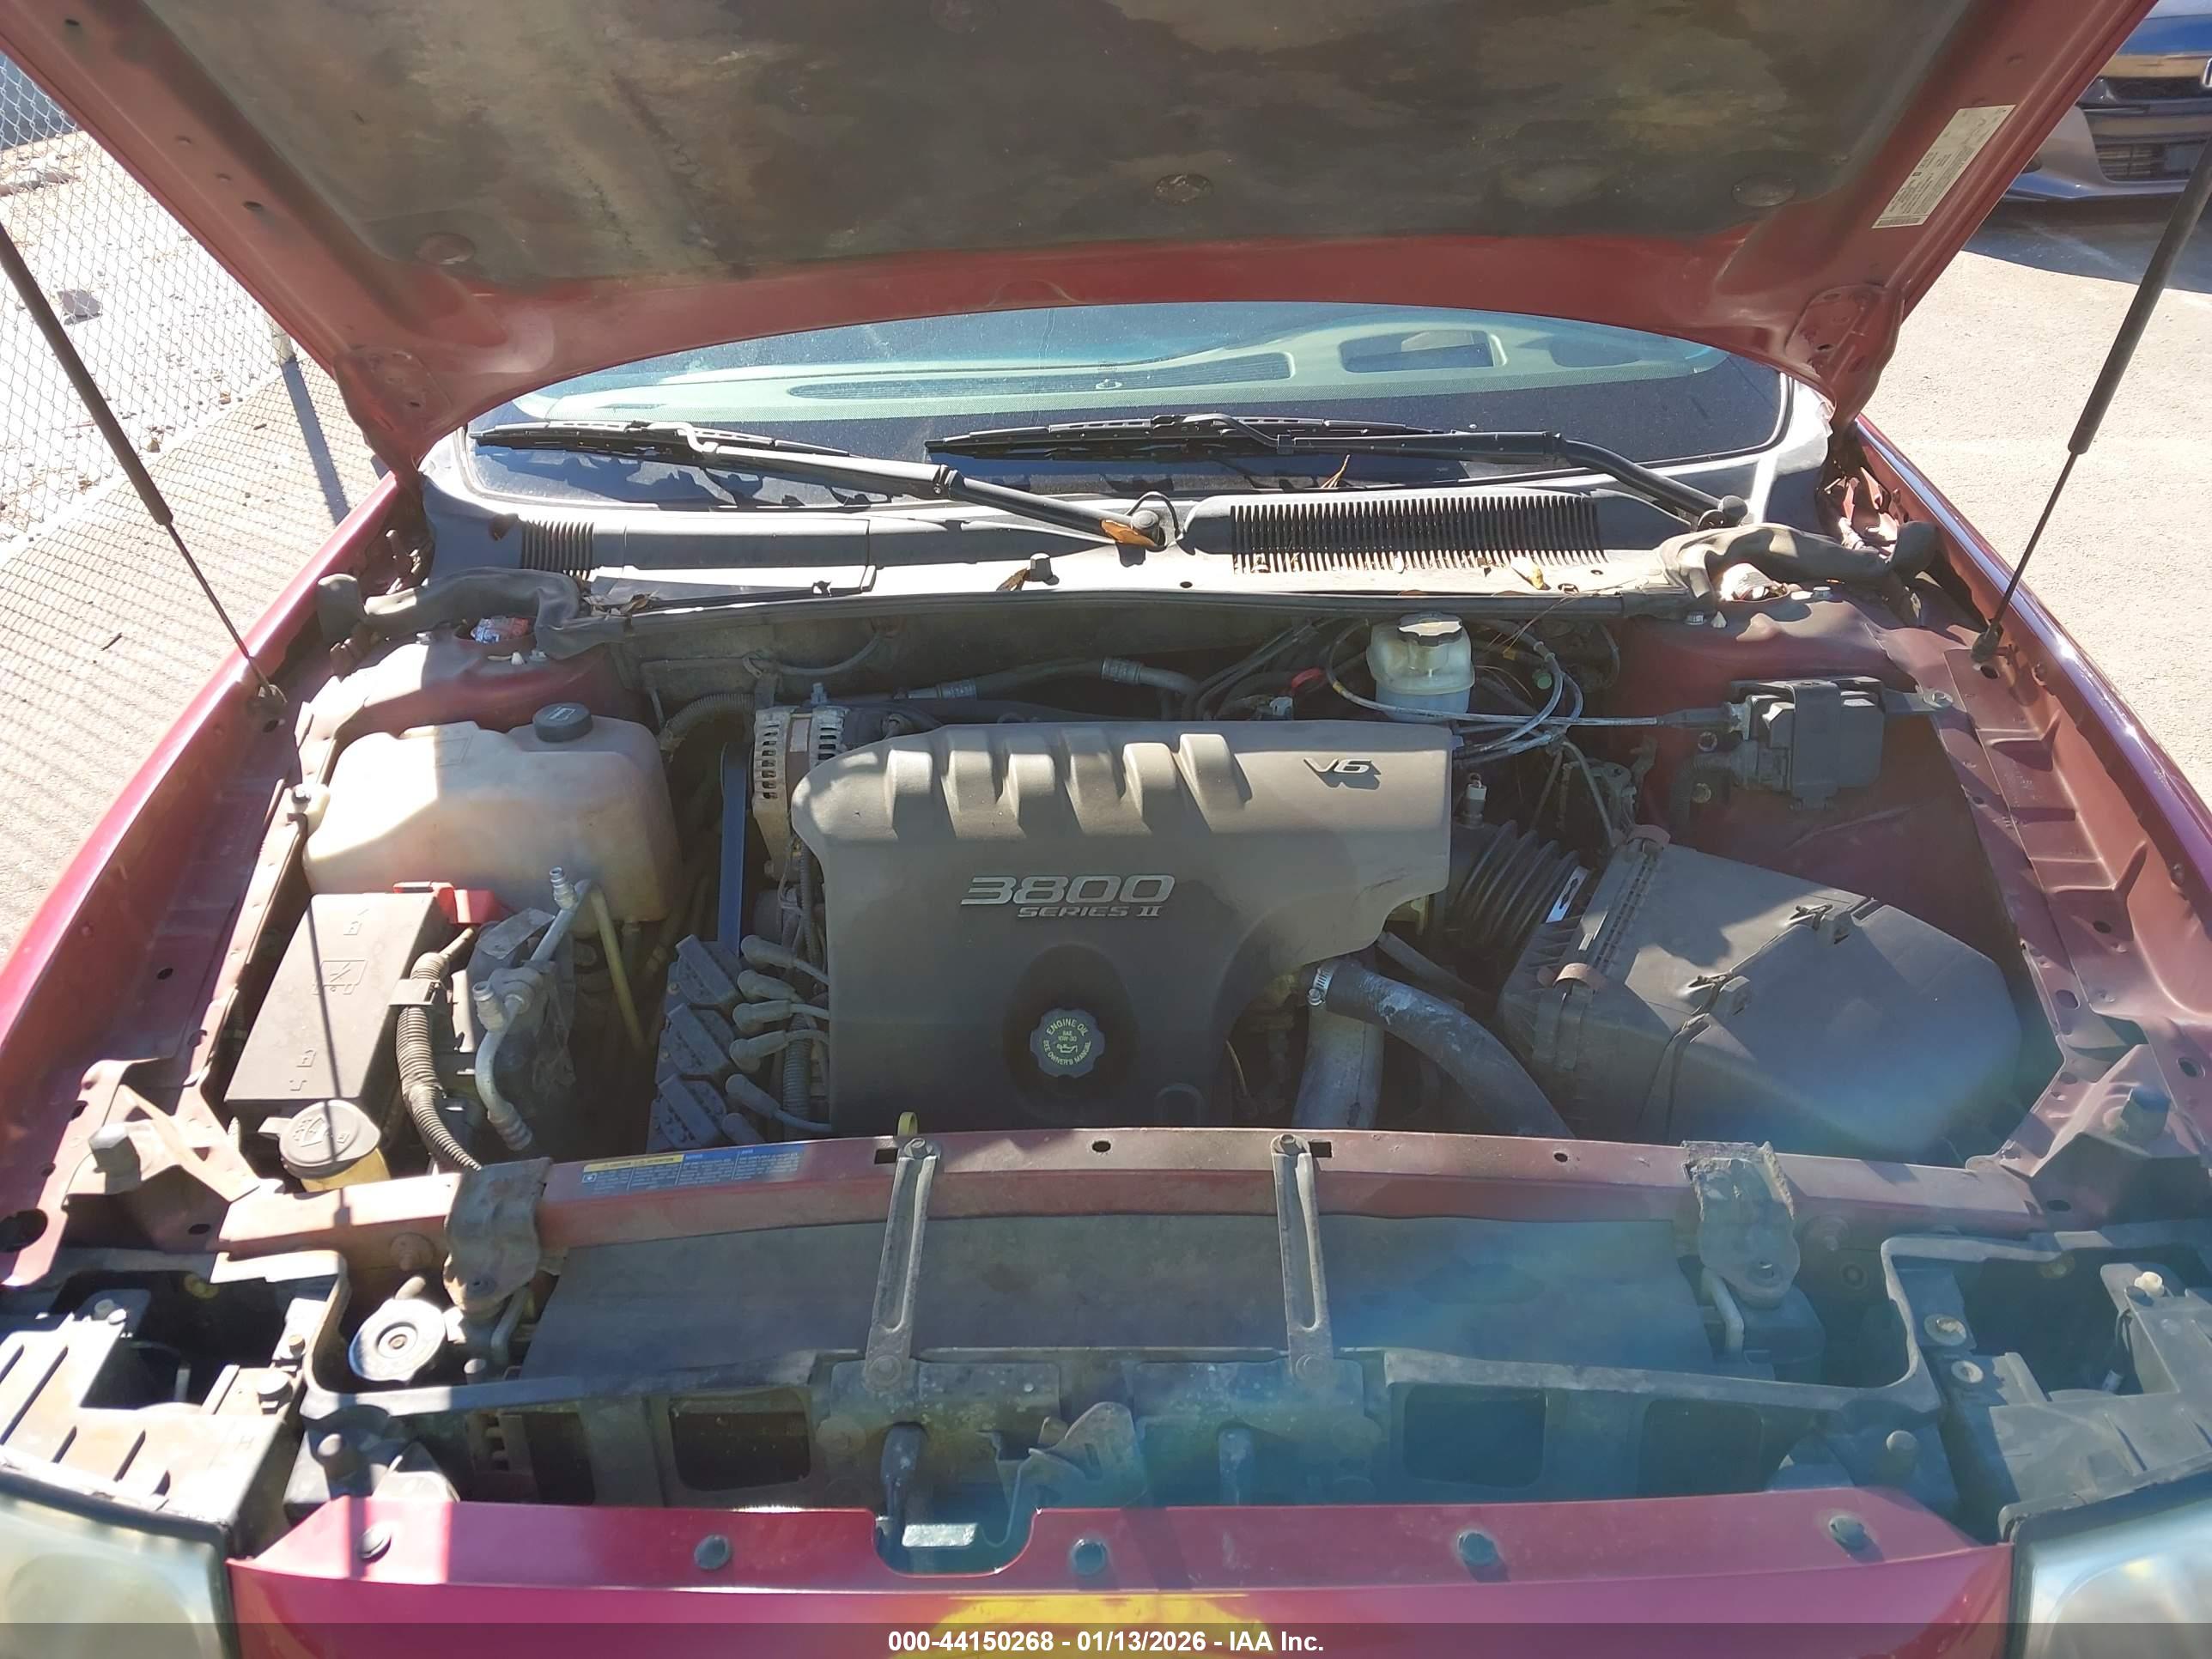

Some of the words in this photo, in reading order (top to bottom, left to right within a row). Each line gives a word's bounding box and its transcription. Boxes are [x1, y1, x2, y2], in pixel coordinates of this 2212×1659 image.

[1303, 757, 1373, 774] V6
[960, 874, 1176, 906] 3800
[1017, 906, 1130, 918] SERIES
[1136, 905, 1162, 918] II
[1046, 1018, 1078, 1036] ENGINE
[1077, 1024, 1090, 1036] OIL
